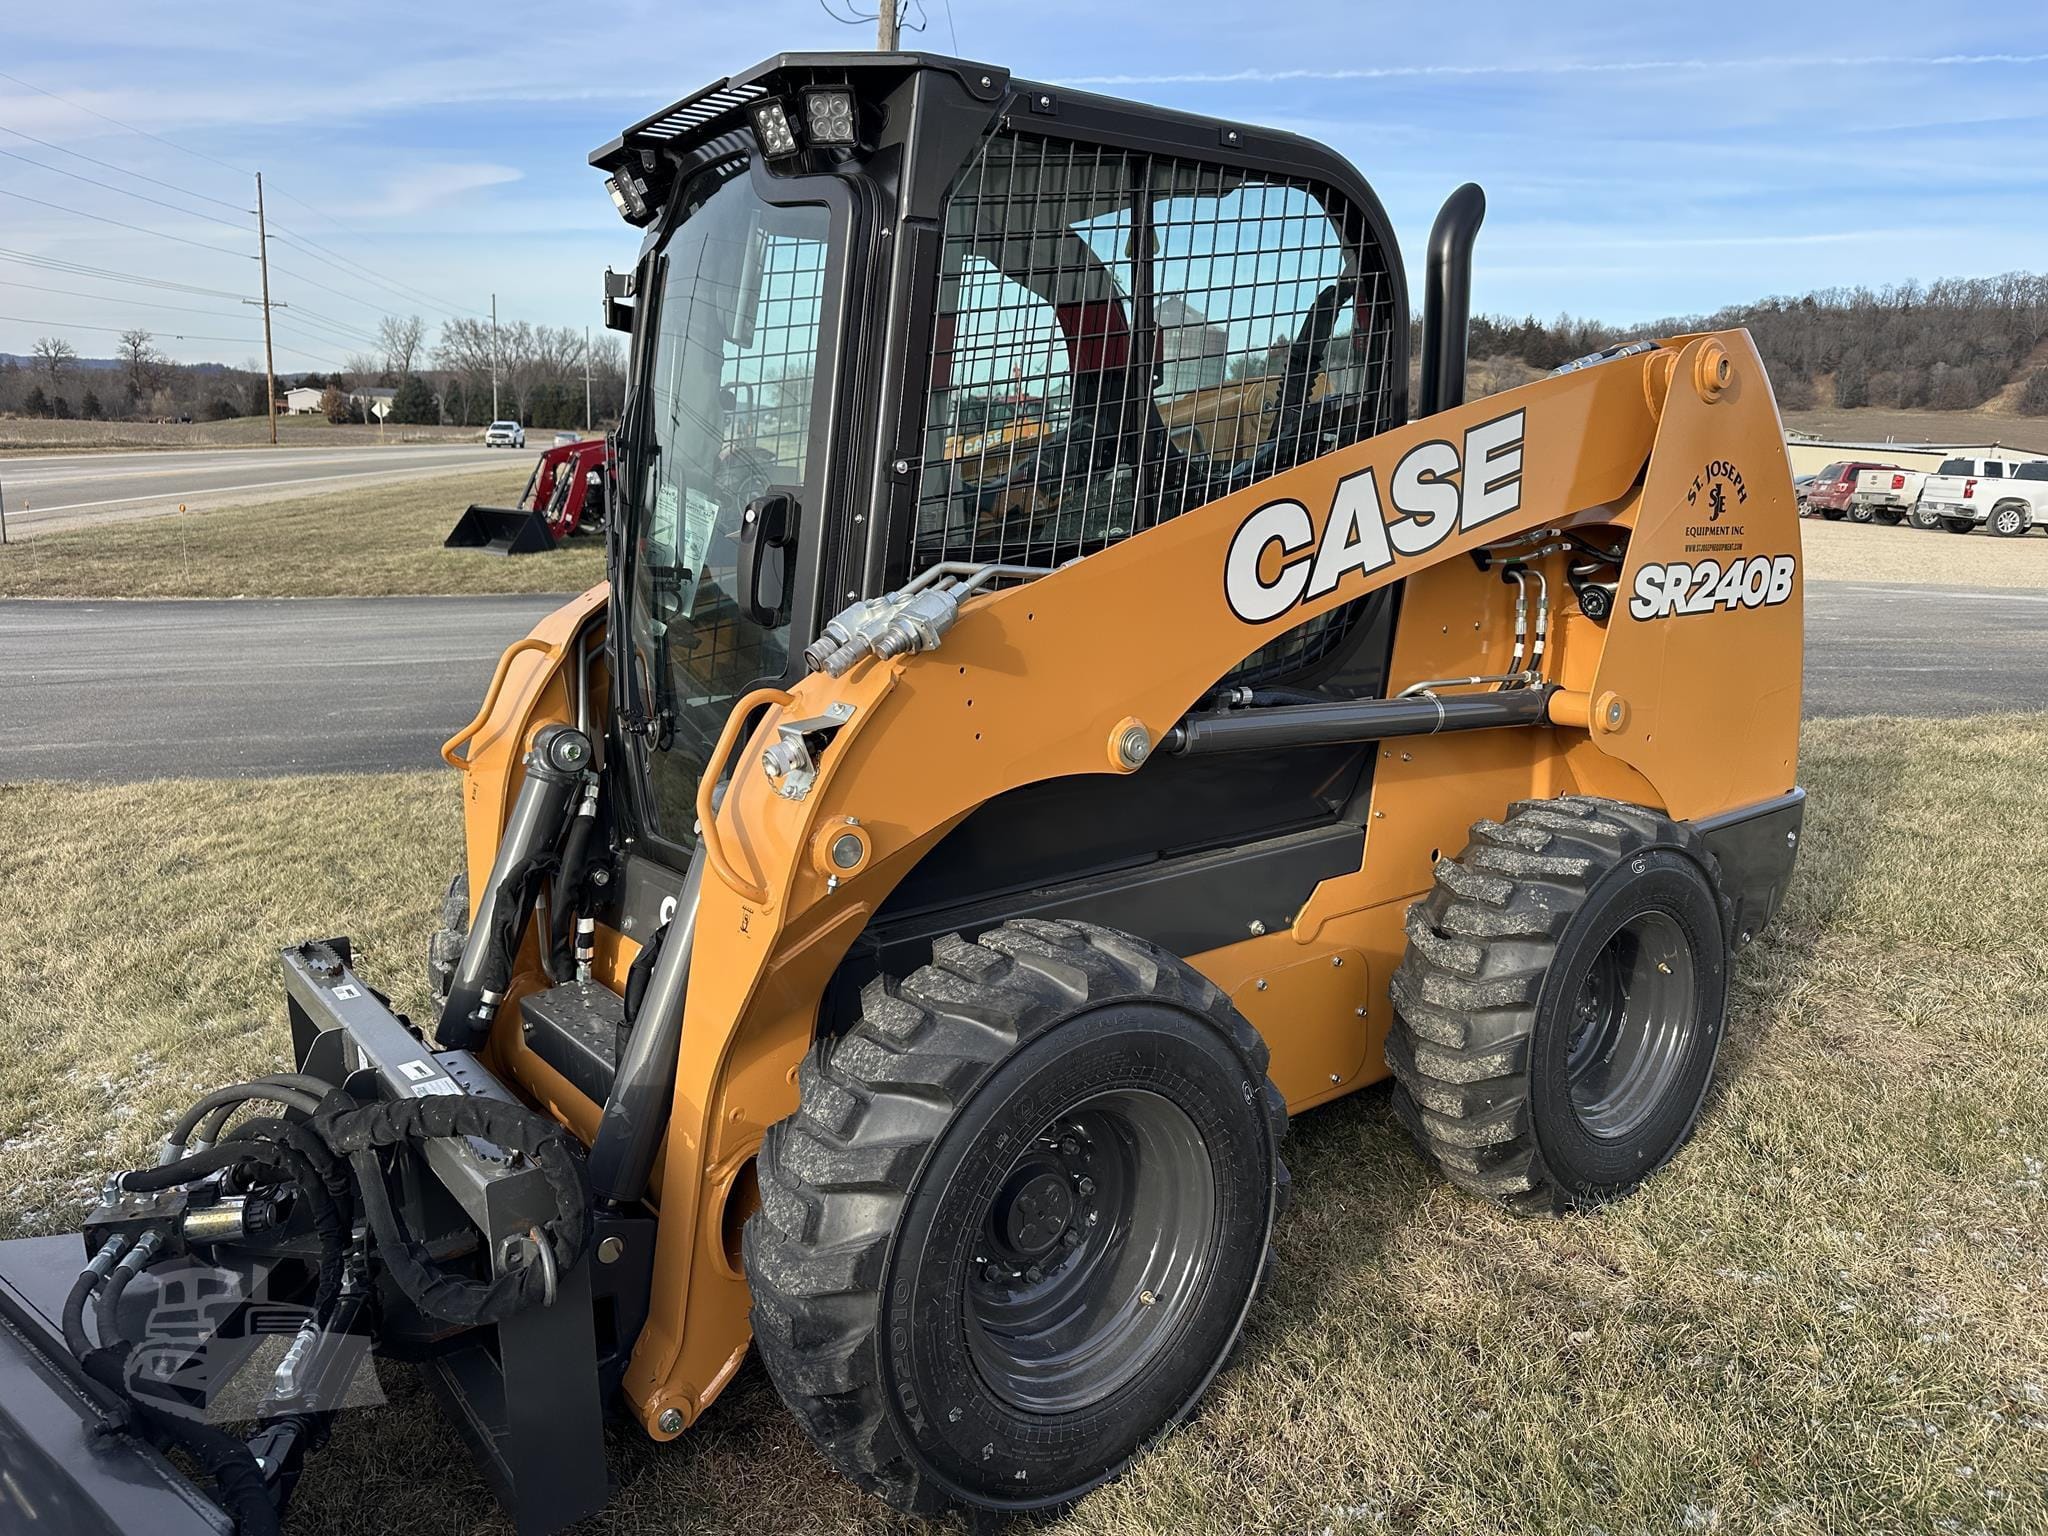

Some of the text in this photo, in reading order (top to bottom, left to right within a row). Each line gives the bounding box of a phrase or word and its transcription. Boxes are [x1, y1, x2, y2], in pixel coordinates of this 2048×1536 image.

[964, 430, 1002, 454] CASE
[1687, 460, 1747, 506] ST. JOSEPH
[1224, 407, 1526, 624] CASE
[1685, 526, 1744, 537] EQUIPMENT INC
[1629, 554, 1796, 622] SR240B
